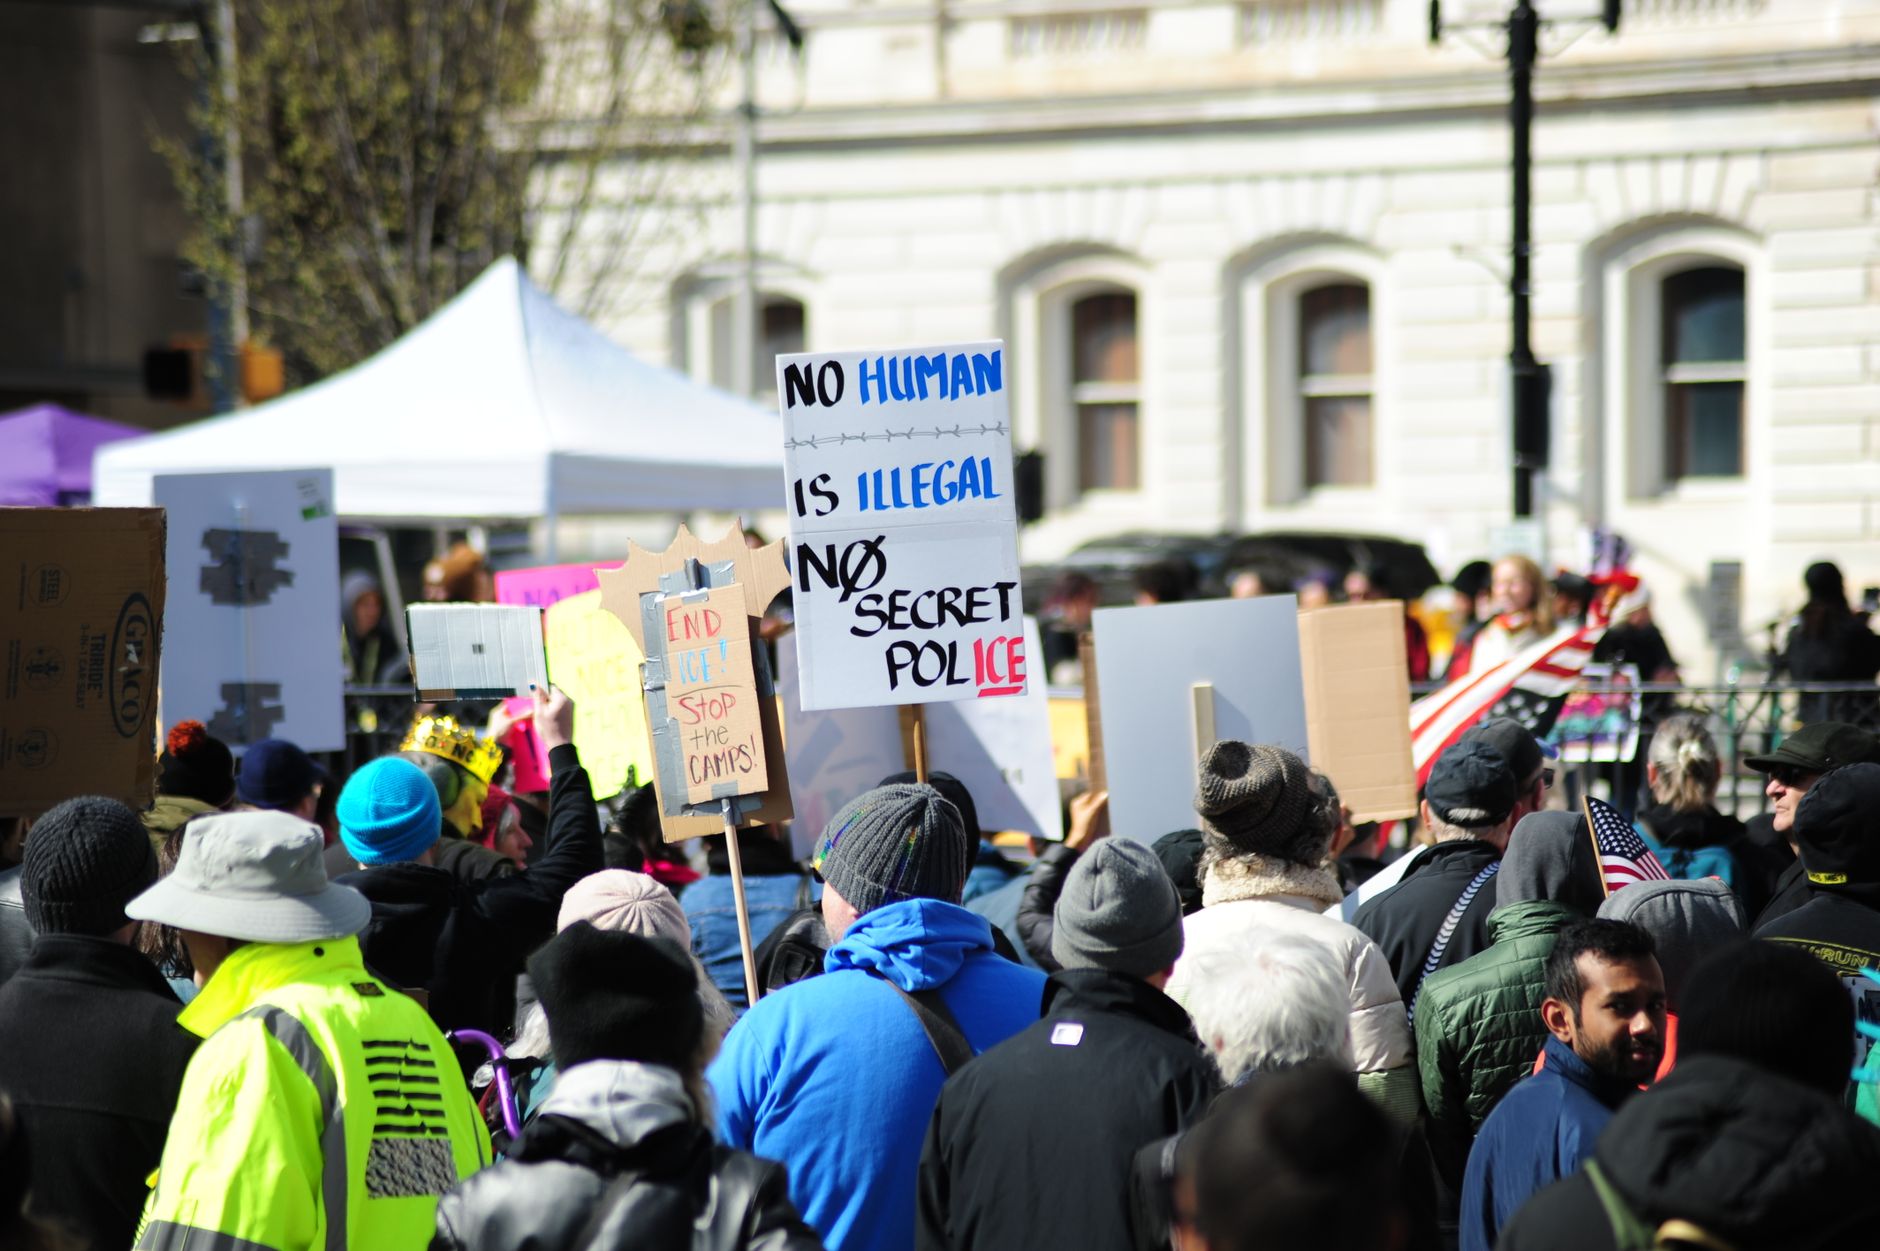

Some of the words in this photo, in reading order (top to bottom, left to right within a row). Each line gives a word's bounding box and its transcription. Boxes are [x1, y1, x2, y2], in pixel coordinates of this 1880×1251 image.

[784, 360, 844, 408] NO
[859, 350, 1002, 405] HUMAN
[794, 473, 839, 517] IS
[858, 455, 1003, 512] ILLEGAL
[667, 604, 721, 642] END
[850, 582, 1017, 637] SECRET
[678, 639, 727, 684] ICE!
[886, 636, 1026, 692] POLICE
[690, 726, 729, 750] the
[690, 733, 757, 784] CAMPS!
